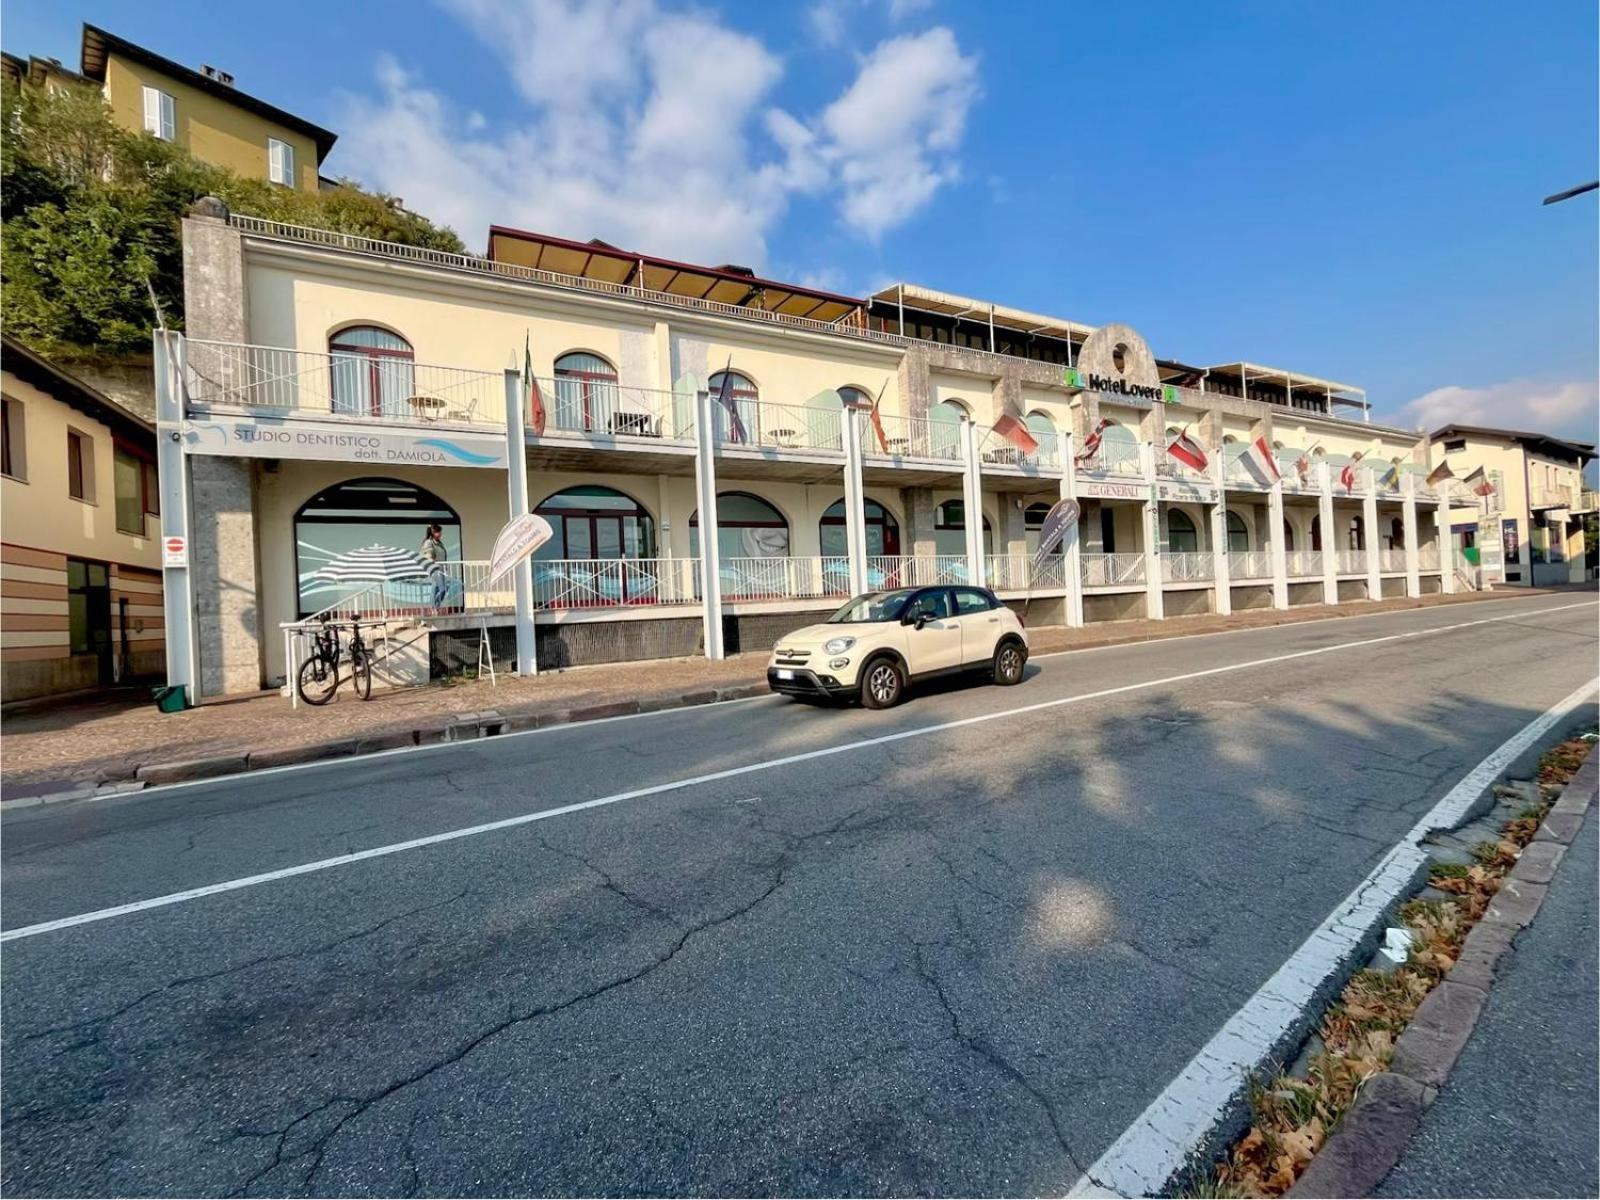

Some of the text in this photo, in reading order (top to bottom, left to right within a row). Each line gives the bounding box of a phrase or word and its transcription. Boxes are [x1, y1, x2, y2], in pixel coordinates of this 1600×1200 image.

[234, 429, 381, 449] STUDIO DENTISTICO
[354, 449, 447, 463] dott. DAMIOLA
[1100, 485, 1138, 497] GENERALI
